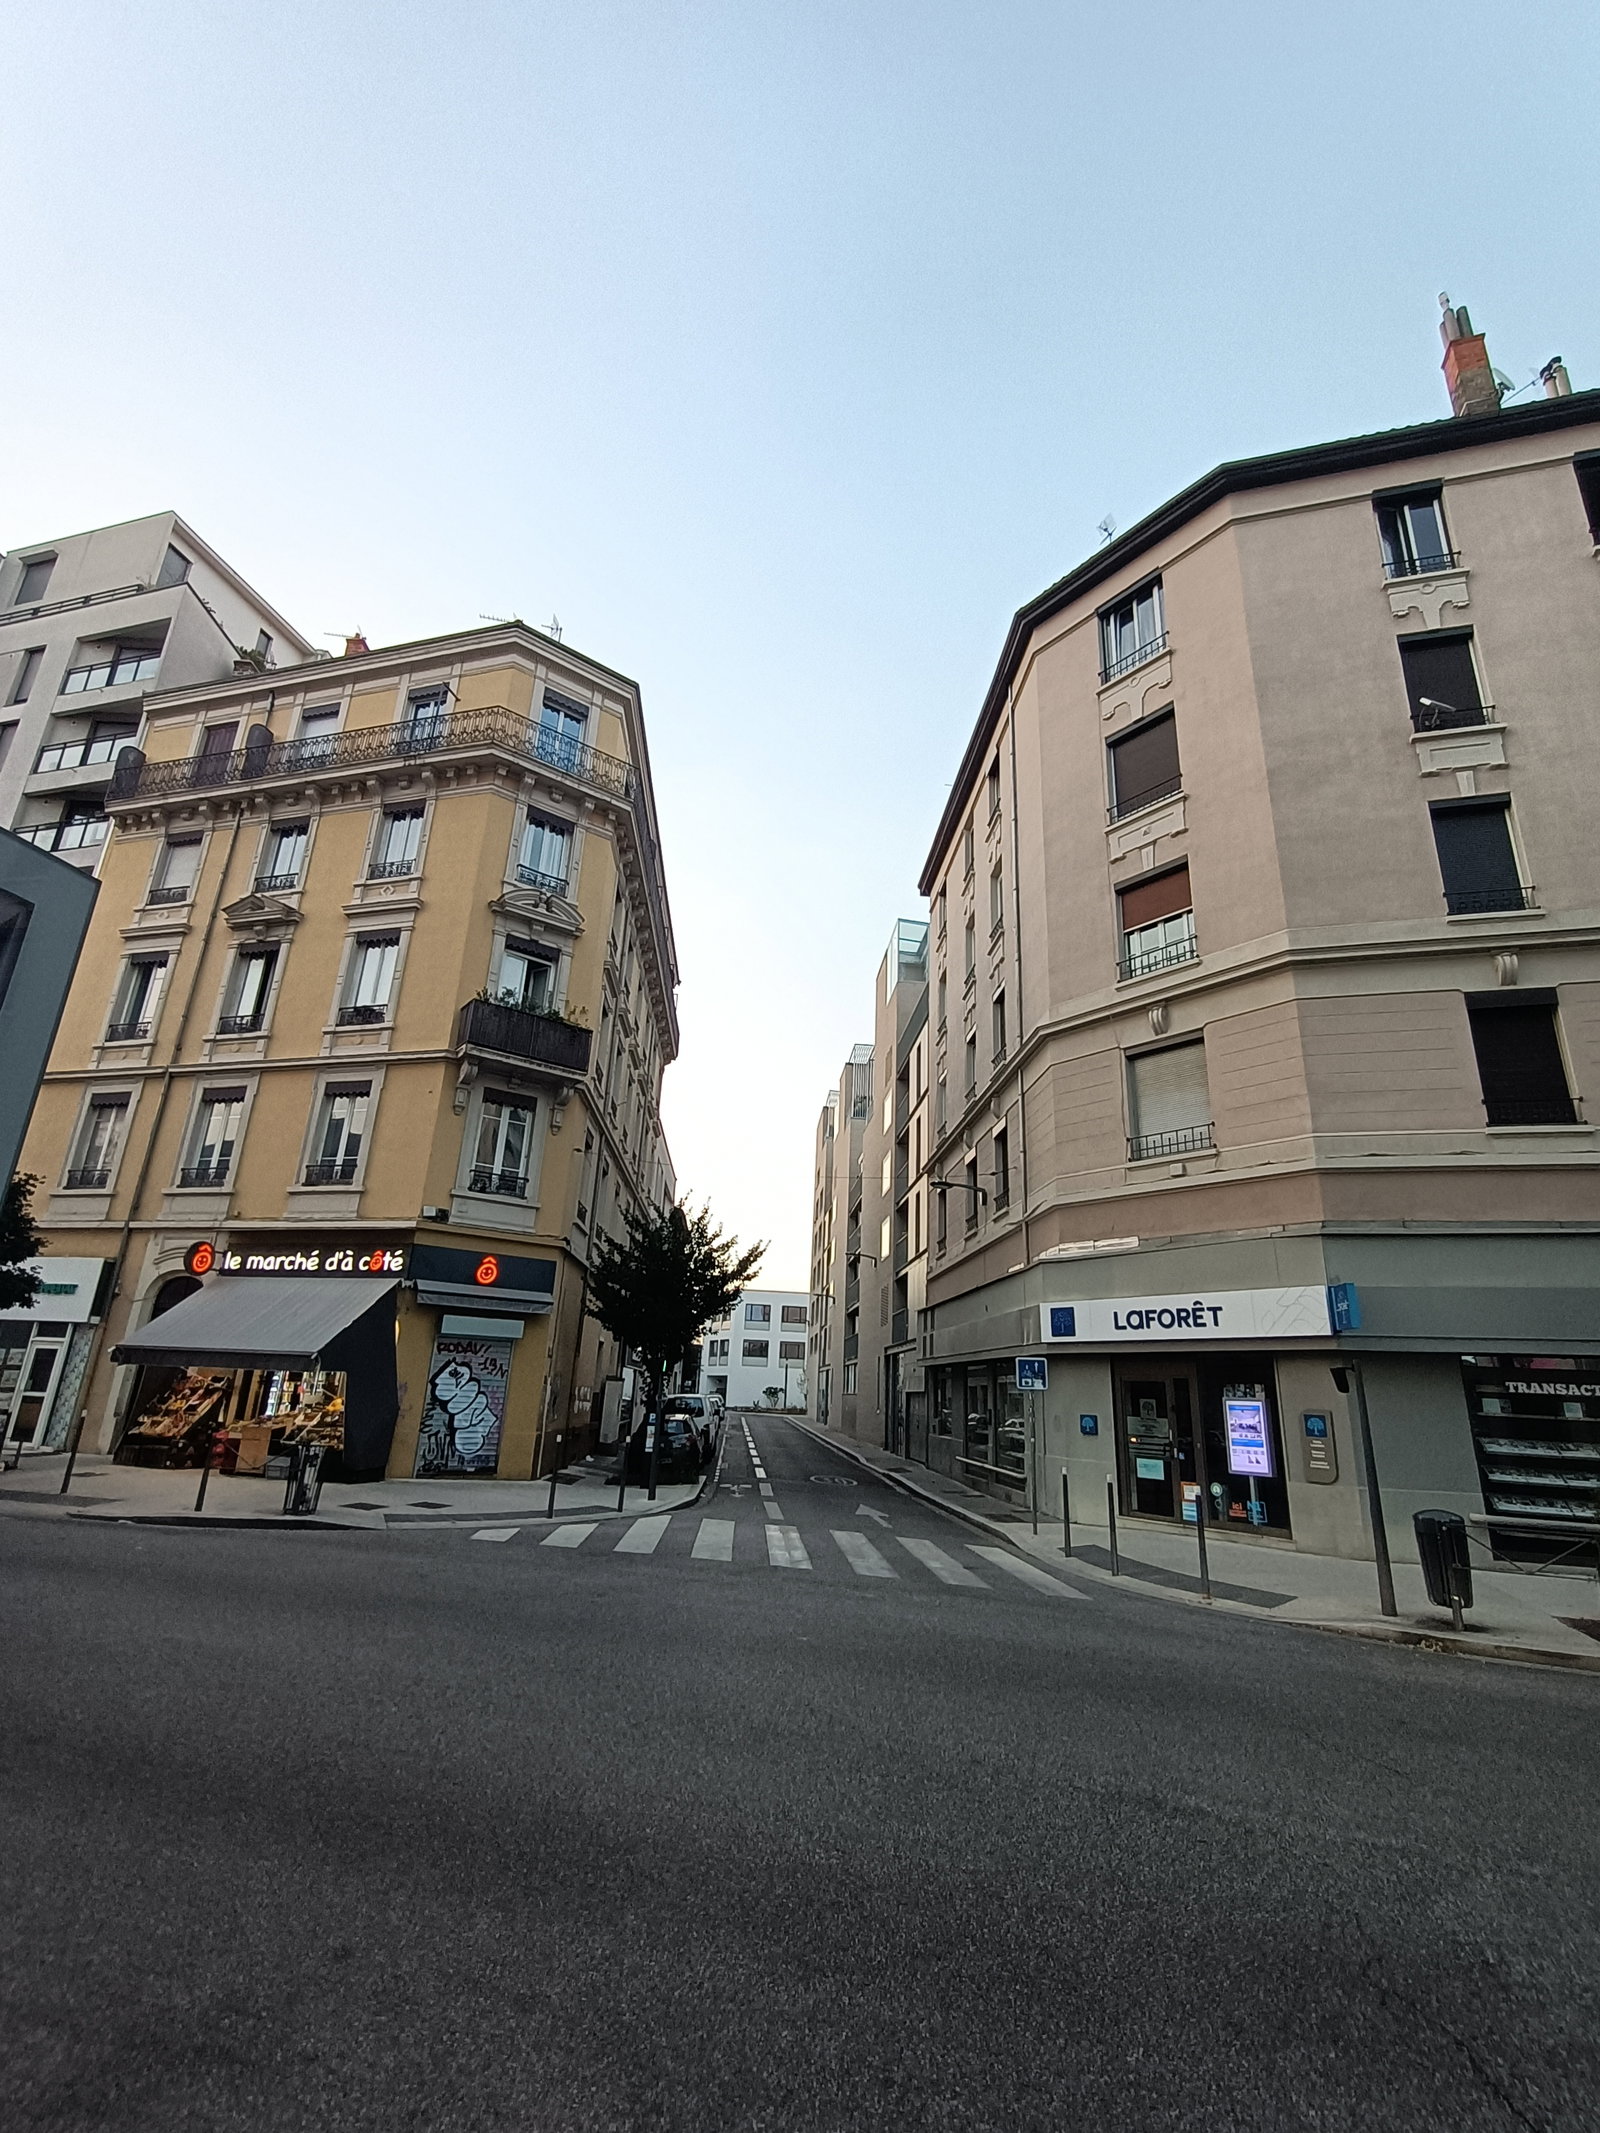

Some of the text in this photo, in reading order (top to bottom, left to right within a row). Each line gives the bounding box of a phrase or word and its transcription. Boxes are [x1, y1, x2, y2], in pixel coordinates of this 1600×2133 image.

[223, 1250, 404, 1271] le marché d'à côté
